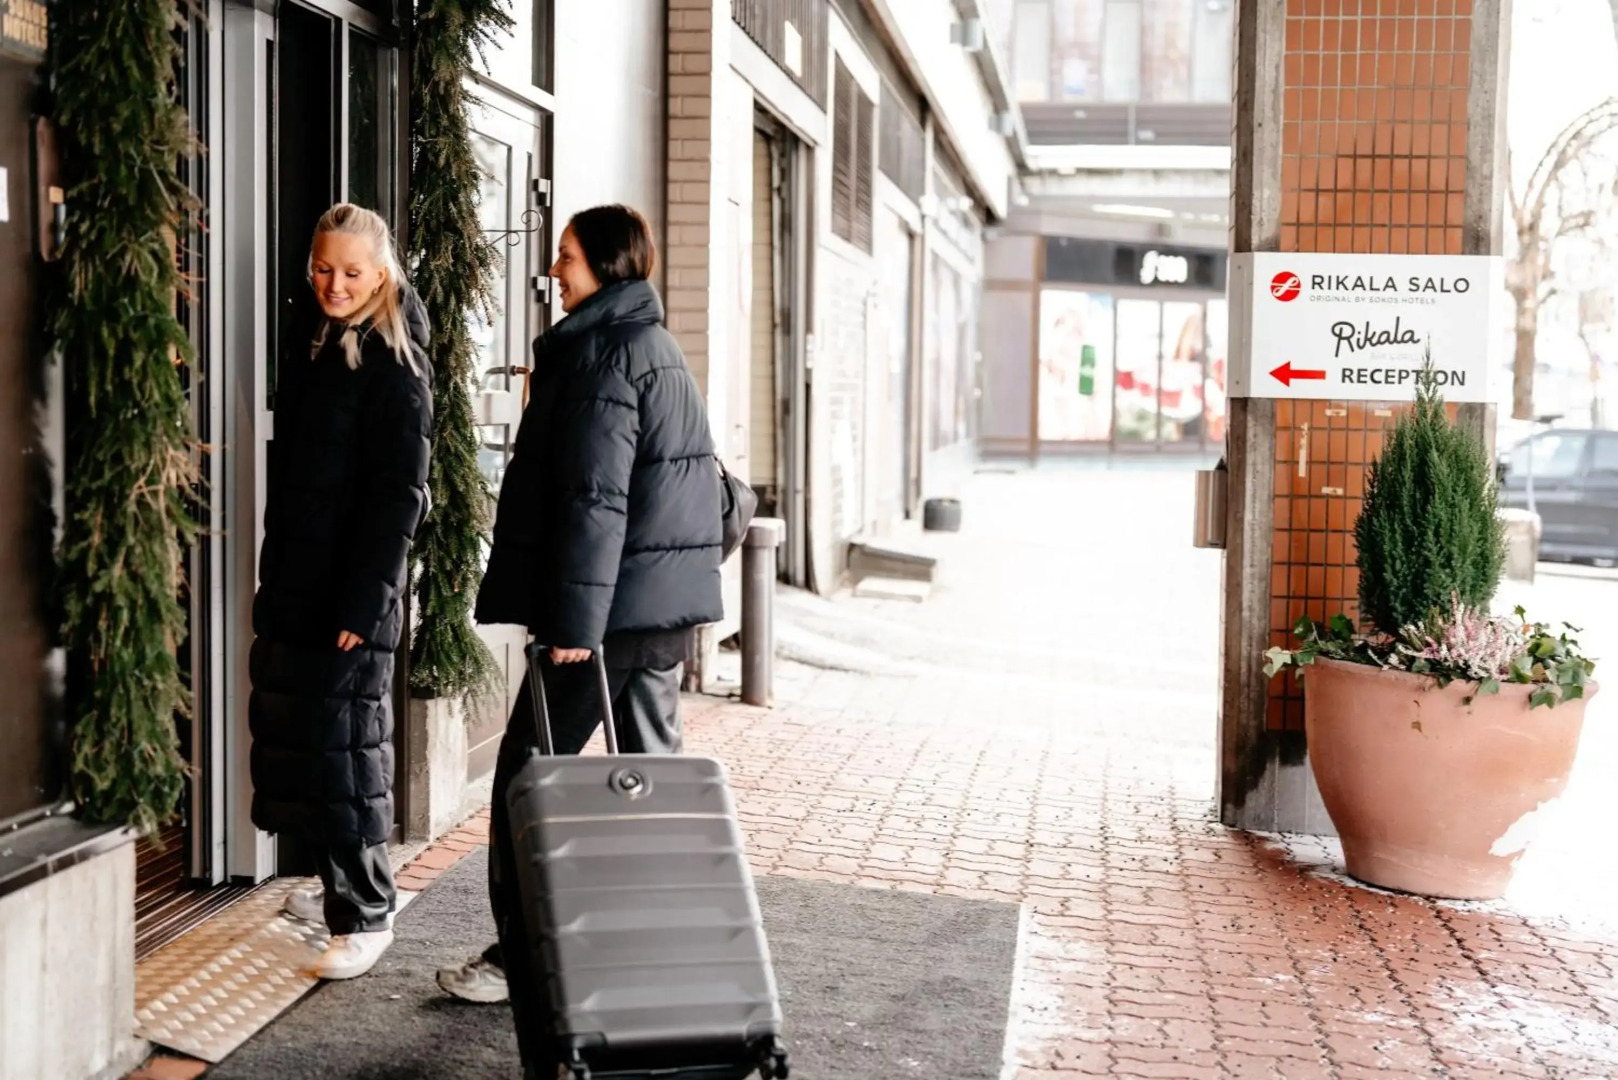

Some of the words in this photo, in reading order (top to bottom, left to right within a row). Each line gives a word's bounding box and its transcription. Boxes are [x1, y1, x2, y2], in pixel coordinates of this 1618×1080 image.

[1311, 274, 1398, 292] RIKALA
[1408, 276, 1470, 293] SALO
[1309, 295, 1352, 303] ORIGINAL
[1369, 296, 1399, 304] SOKOS
[1401, 297, 1436, 305] HOTELS
[1331, 316, 1421, 358] Rikala
[1341, 368, 1466, 386] RECEPTON
